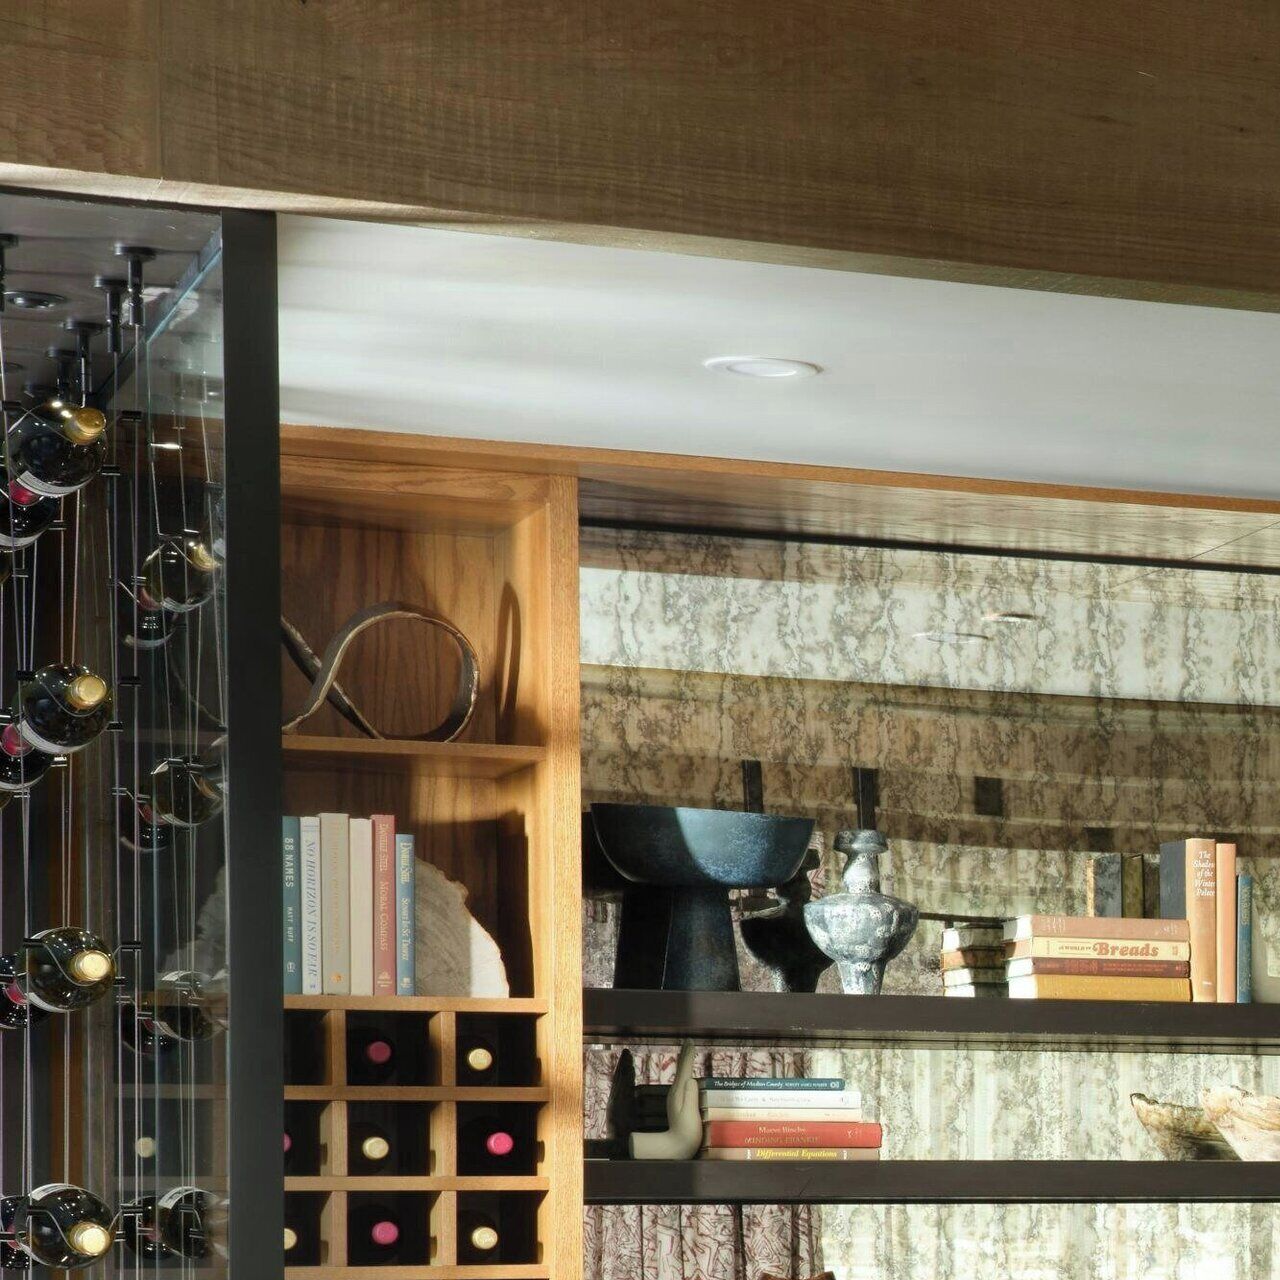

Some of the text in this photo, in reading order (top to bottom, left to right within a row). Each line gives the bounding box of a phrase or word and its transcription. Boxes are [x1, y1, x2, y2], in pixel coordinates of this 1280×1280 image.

[285, 837, 294, 888] 88 NAMES
[305, 861, 317, 915] HORIZON
[1093, 942, 1160, 956] Breads
[757, 1149, 838, 1159] Differential Equations
